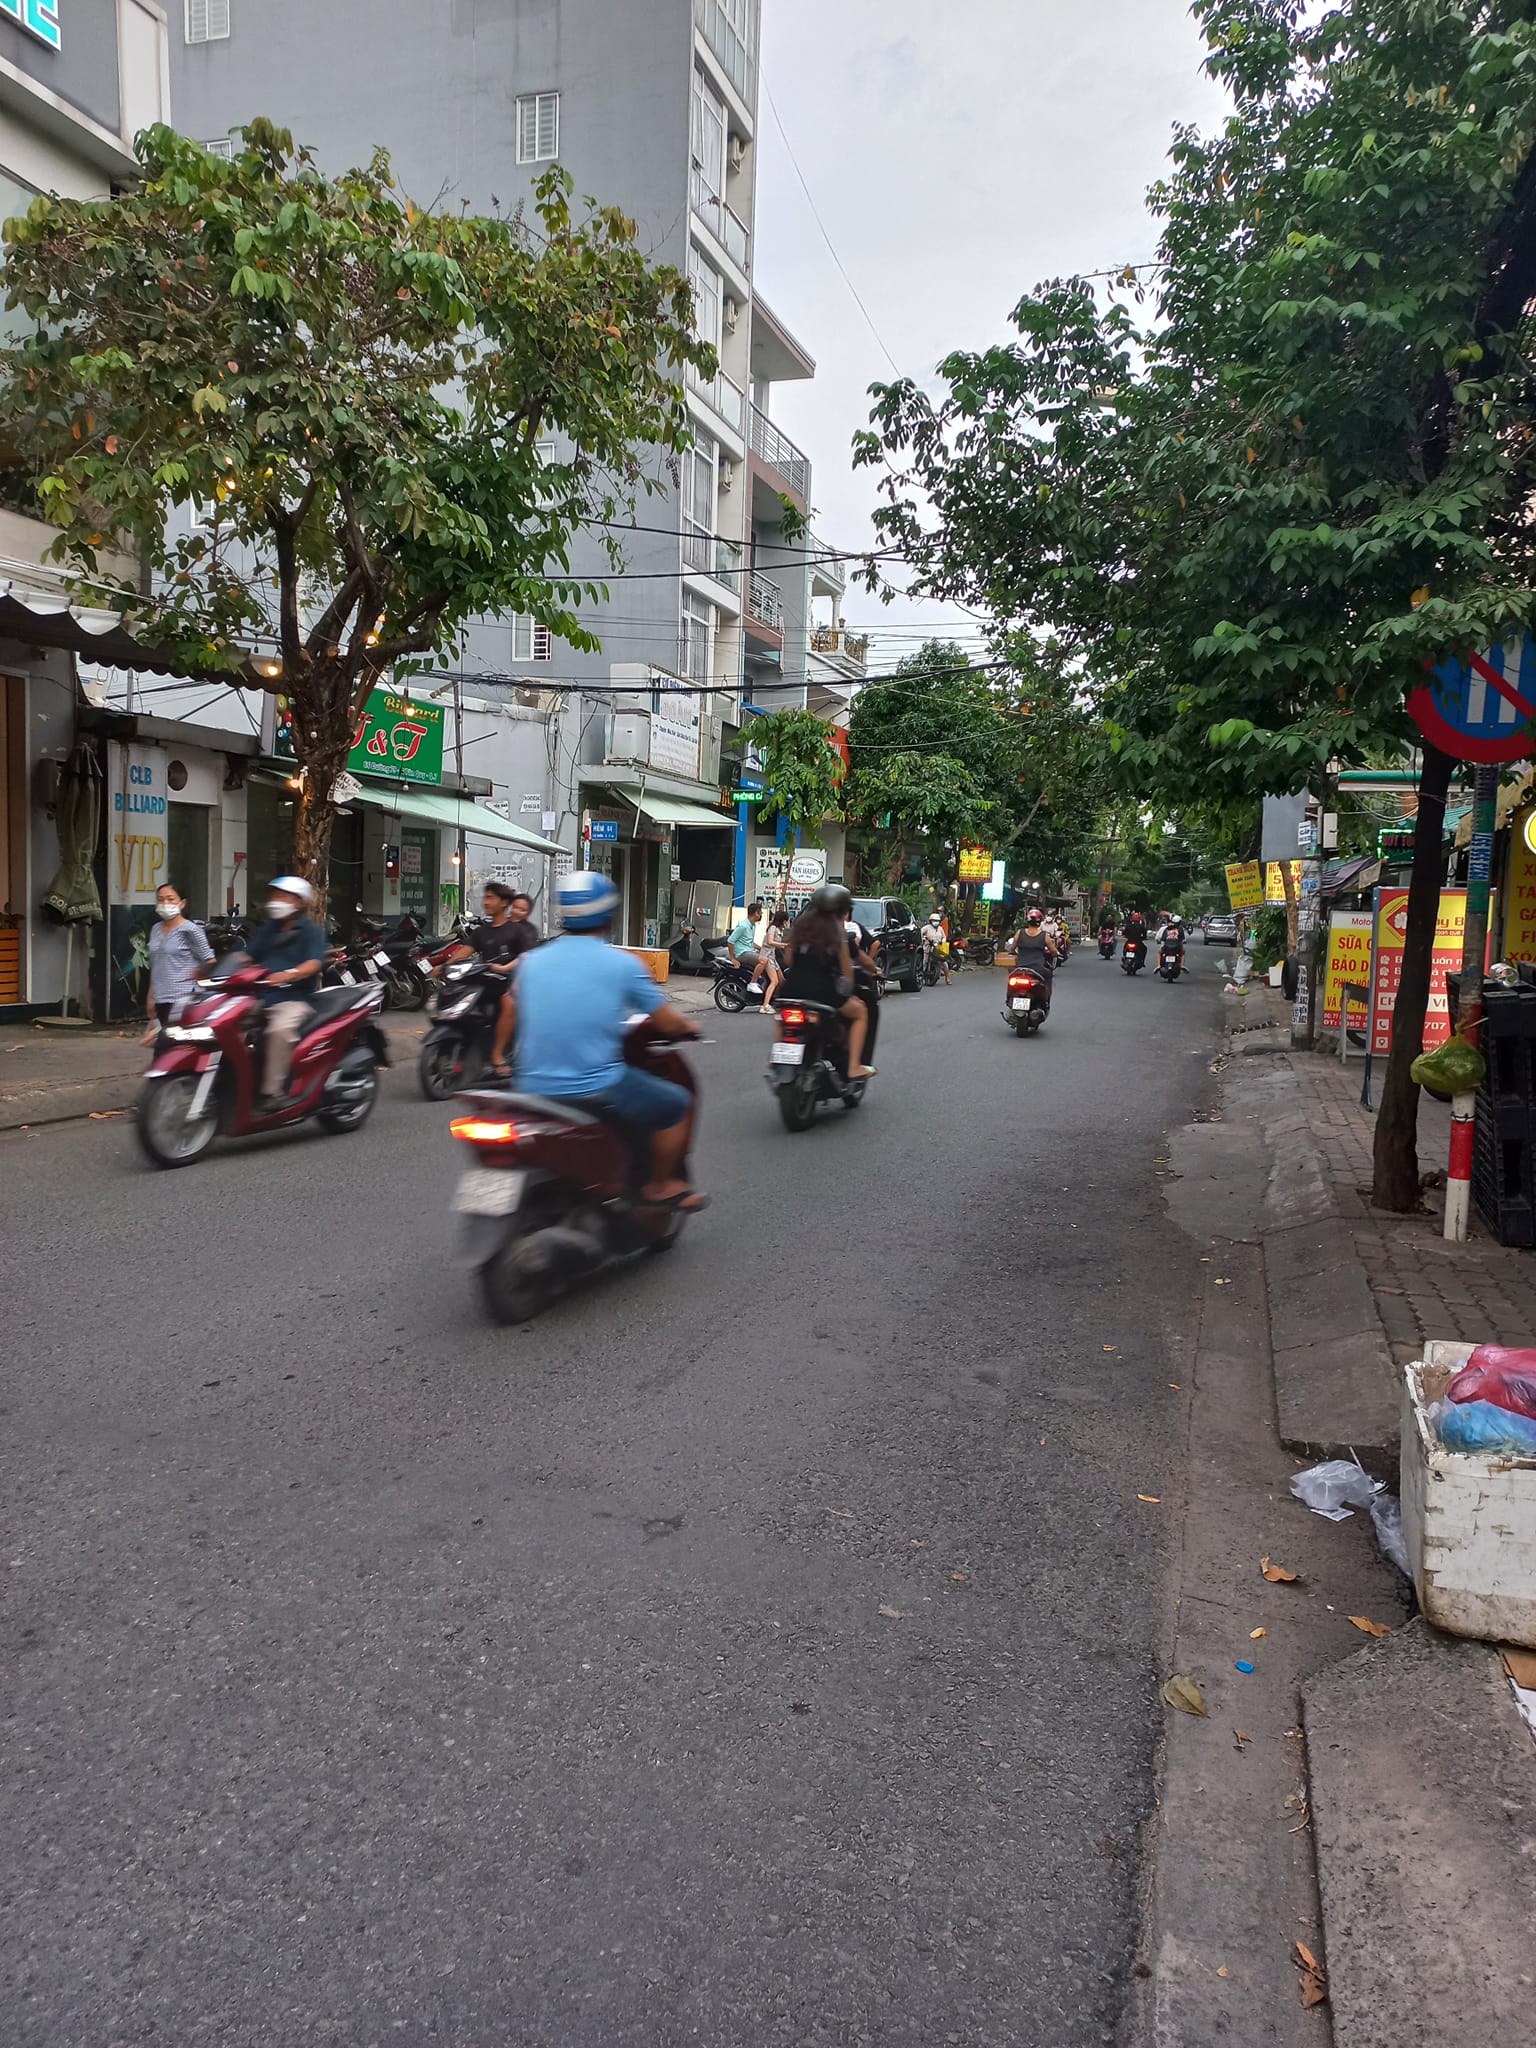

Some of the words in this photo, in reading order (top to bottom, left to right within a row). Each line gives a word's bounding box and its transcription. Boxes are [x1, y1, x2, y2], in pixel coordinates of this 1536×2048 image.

[384, 696, 440, 720] Bilard
[130, 765, 152, 785] CLB
[115, 792, 166, 814] BILLIARD
[114, 834, 164, 892] VIP
[1332, 954, 1357, 972] BẢO
